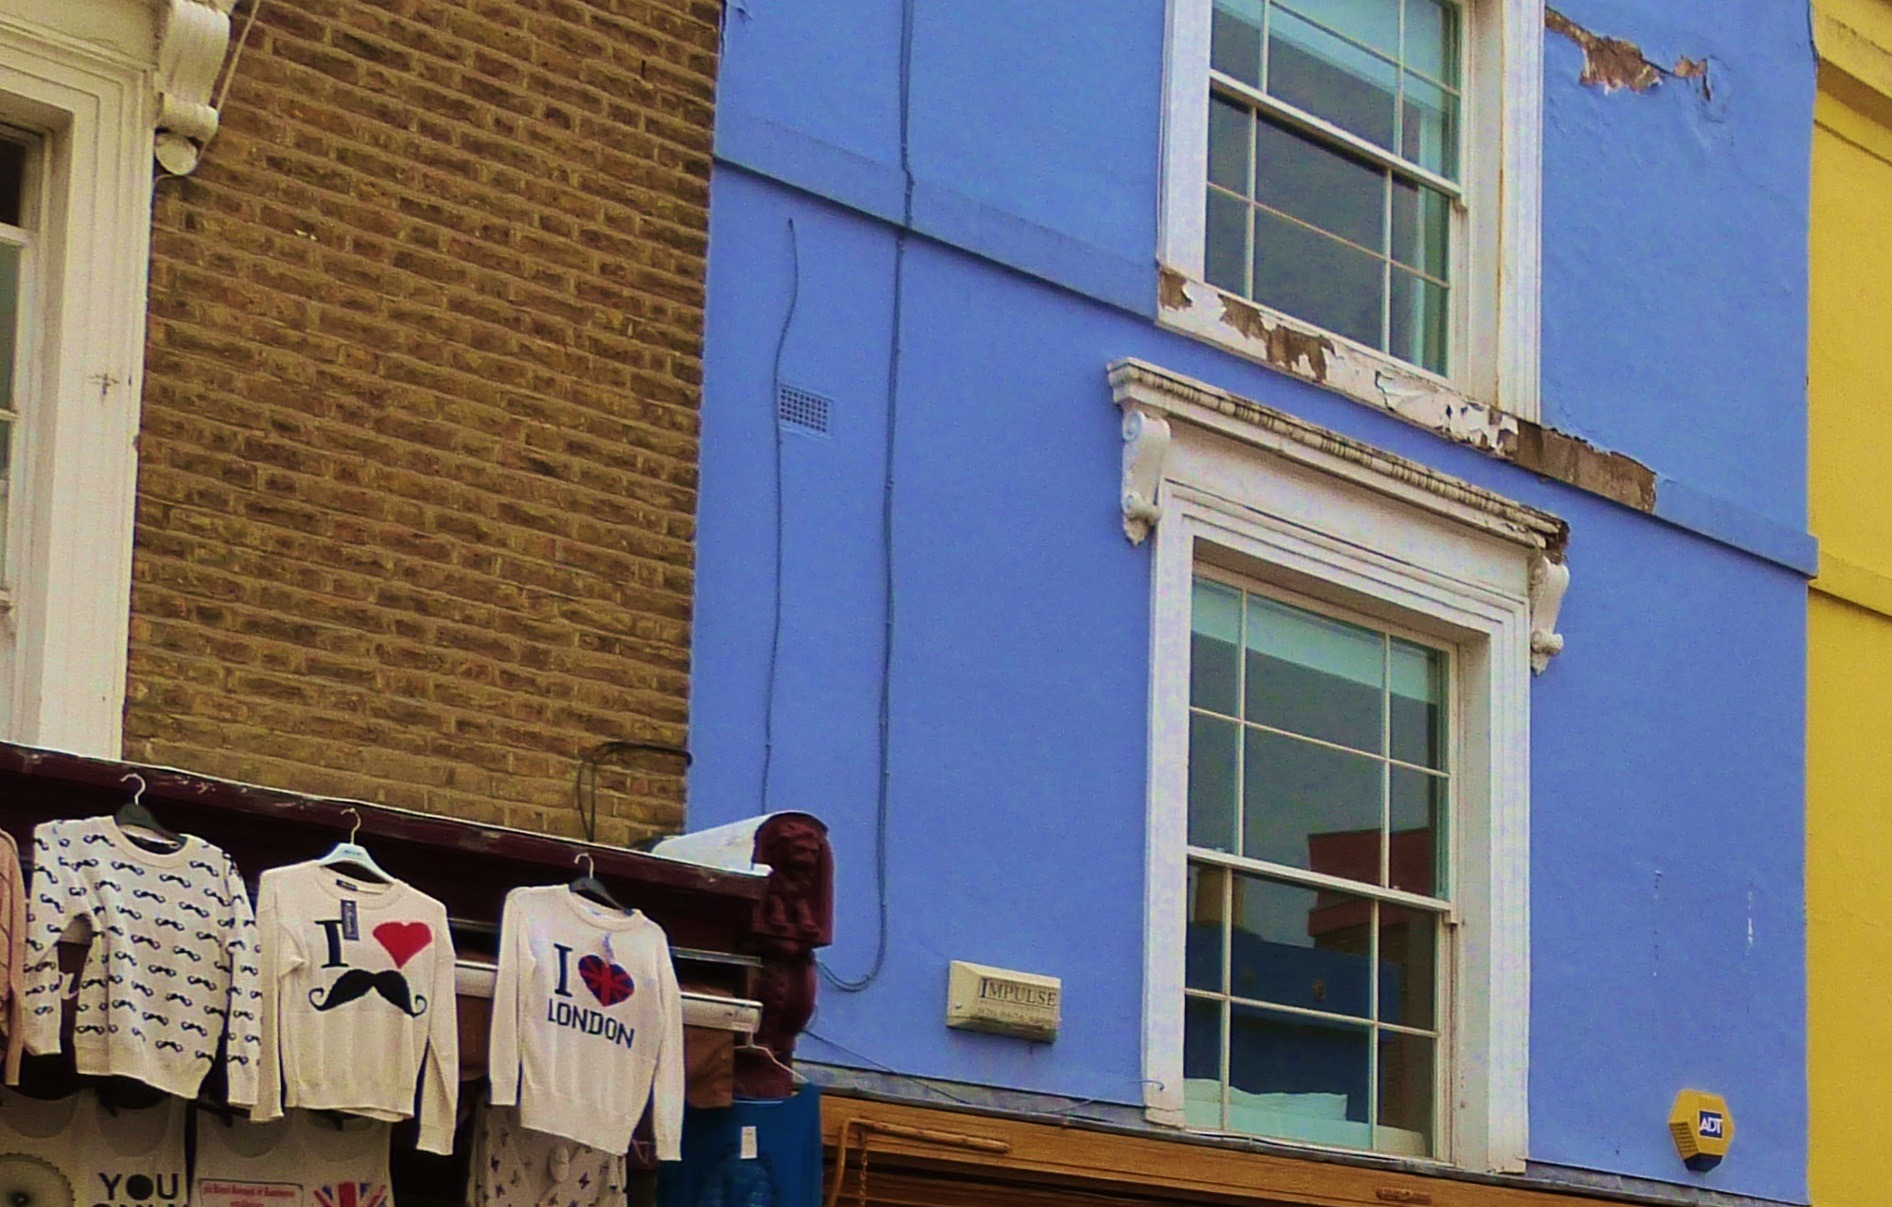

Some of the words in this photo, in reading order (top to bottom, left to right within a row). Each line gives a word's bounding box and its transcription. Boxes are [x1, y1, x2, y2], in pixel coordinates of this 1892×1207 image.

[553, 943, 573, 998] I
[979, 977, 1057, 1007] IMPULSE
[547, 998, 635, 1049] LONDON
[1700, 1116, 1723, 1134] ADT
[97, 1173, 179, 1201] YOU
